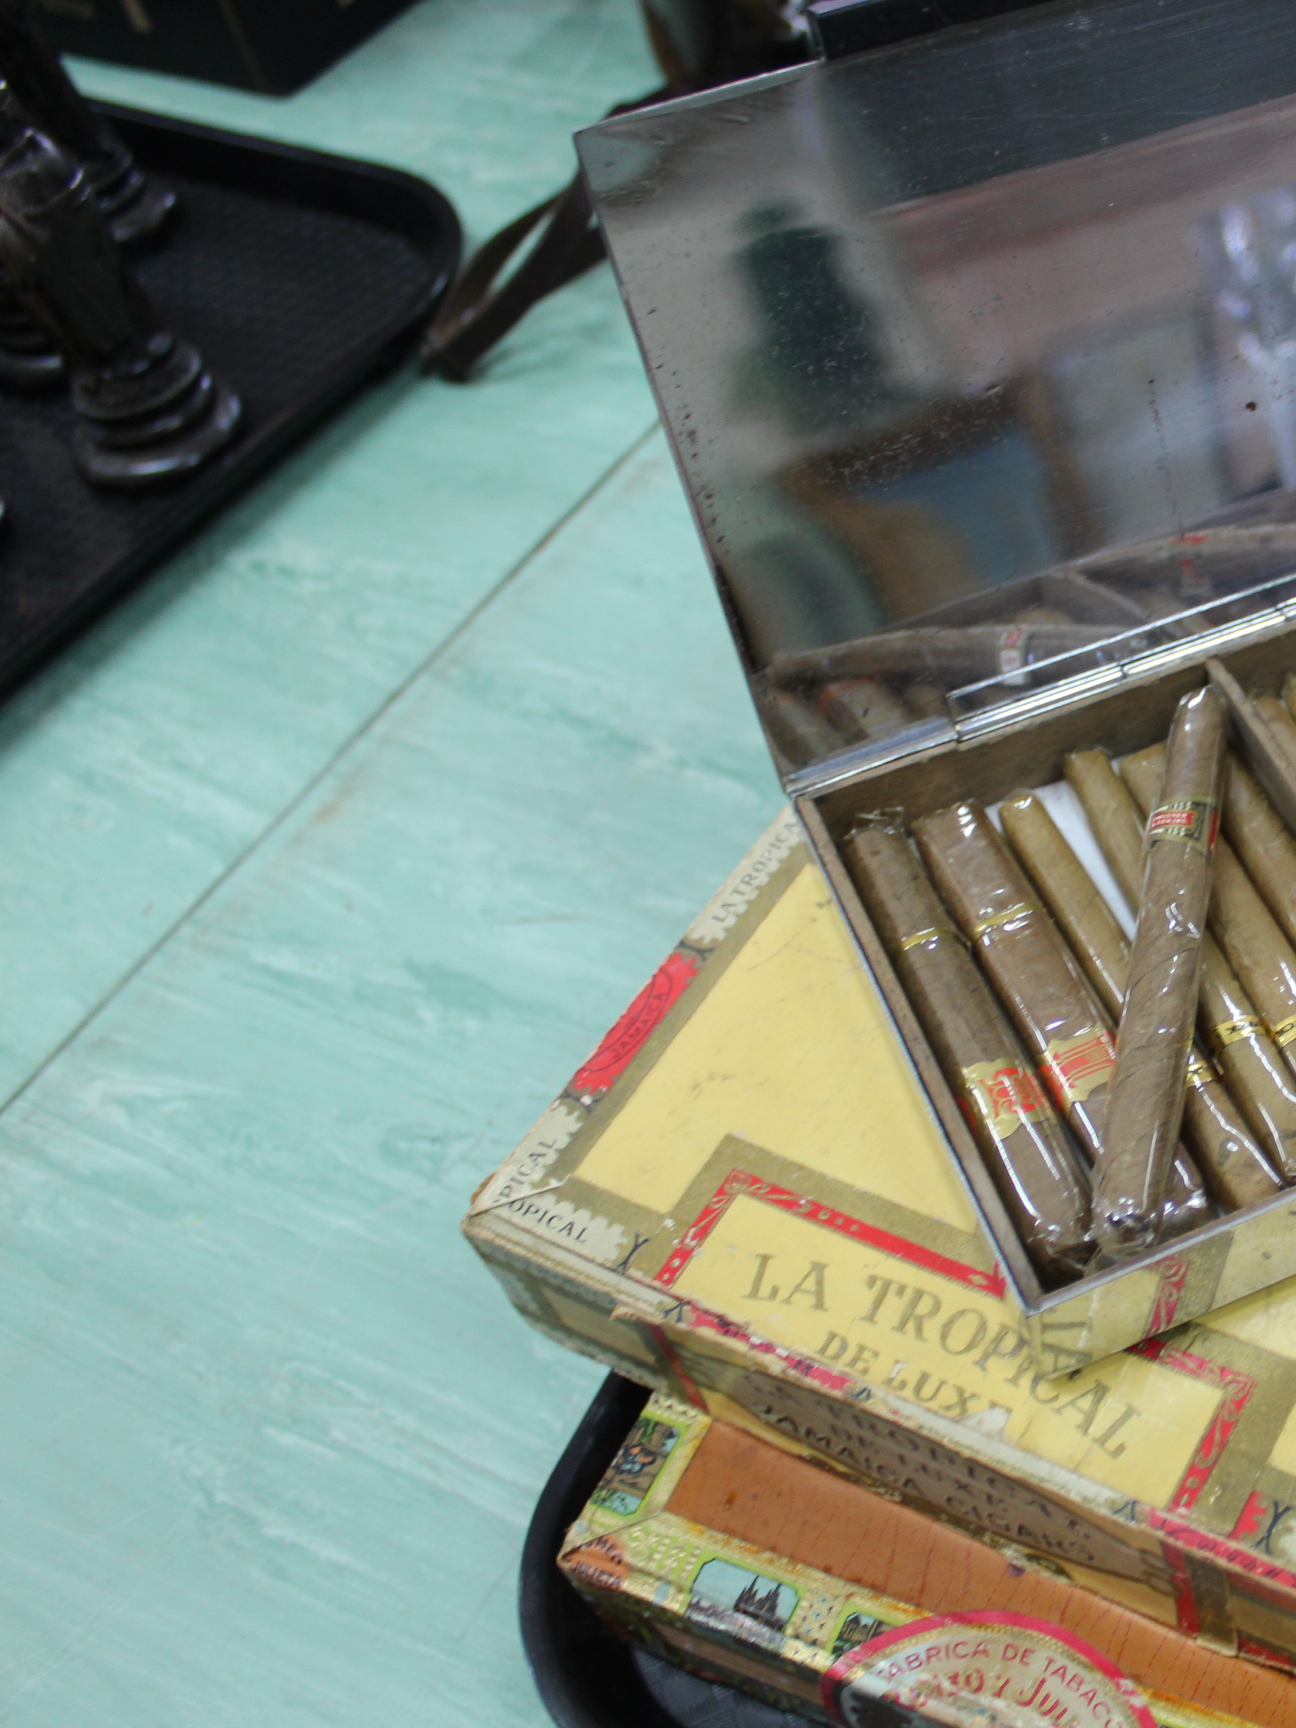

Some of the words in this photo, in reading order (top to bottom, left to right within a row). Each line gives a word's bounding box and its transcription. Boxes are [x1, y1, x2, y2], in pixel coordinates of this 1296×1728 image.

[611, 991, 665, 1060] JAMAICA
[491, 1137, 558, 1204] PICAL
[741, 1253, 831, 1313] LA
[858, 1273, 1142, 1461] TROPICAL
[815, 1330, 881, 1376] DE
[1001, 1643, 1036, 1667] DE
